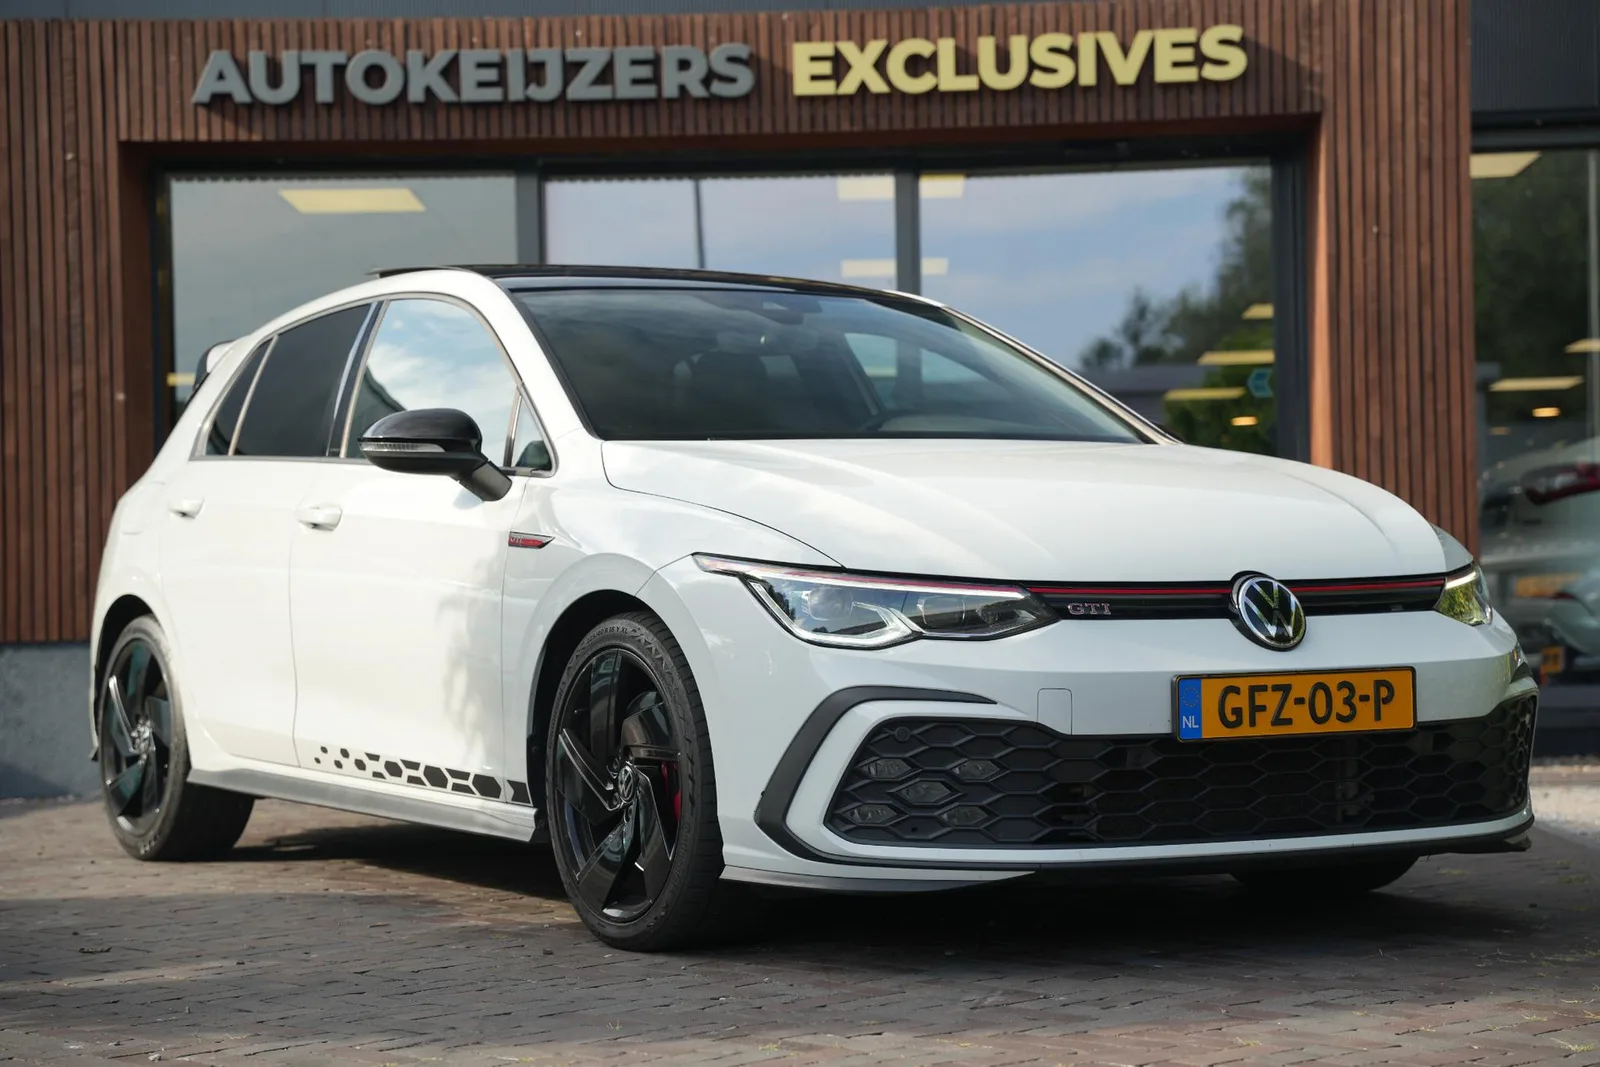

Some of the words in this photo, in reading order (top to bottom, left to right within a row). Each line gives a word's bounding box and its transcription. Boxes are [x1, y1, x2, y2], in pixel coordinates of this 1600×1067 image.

[190, 43, 755, 105] AUTOKEIJZERS
[793, 24, 1248, 97] EXCLUSIVES
[1068, 602, 1112, 615] GTI
[1217, 679, 1395, 729] GFZ-03-P
[1182, 715, 1200, 729] NL
